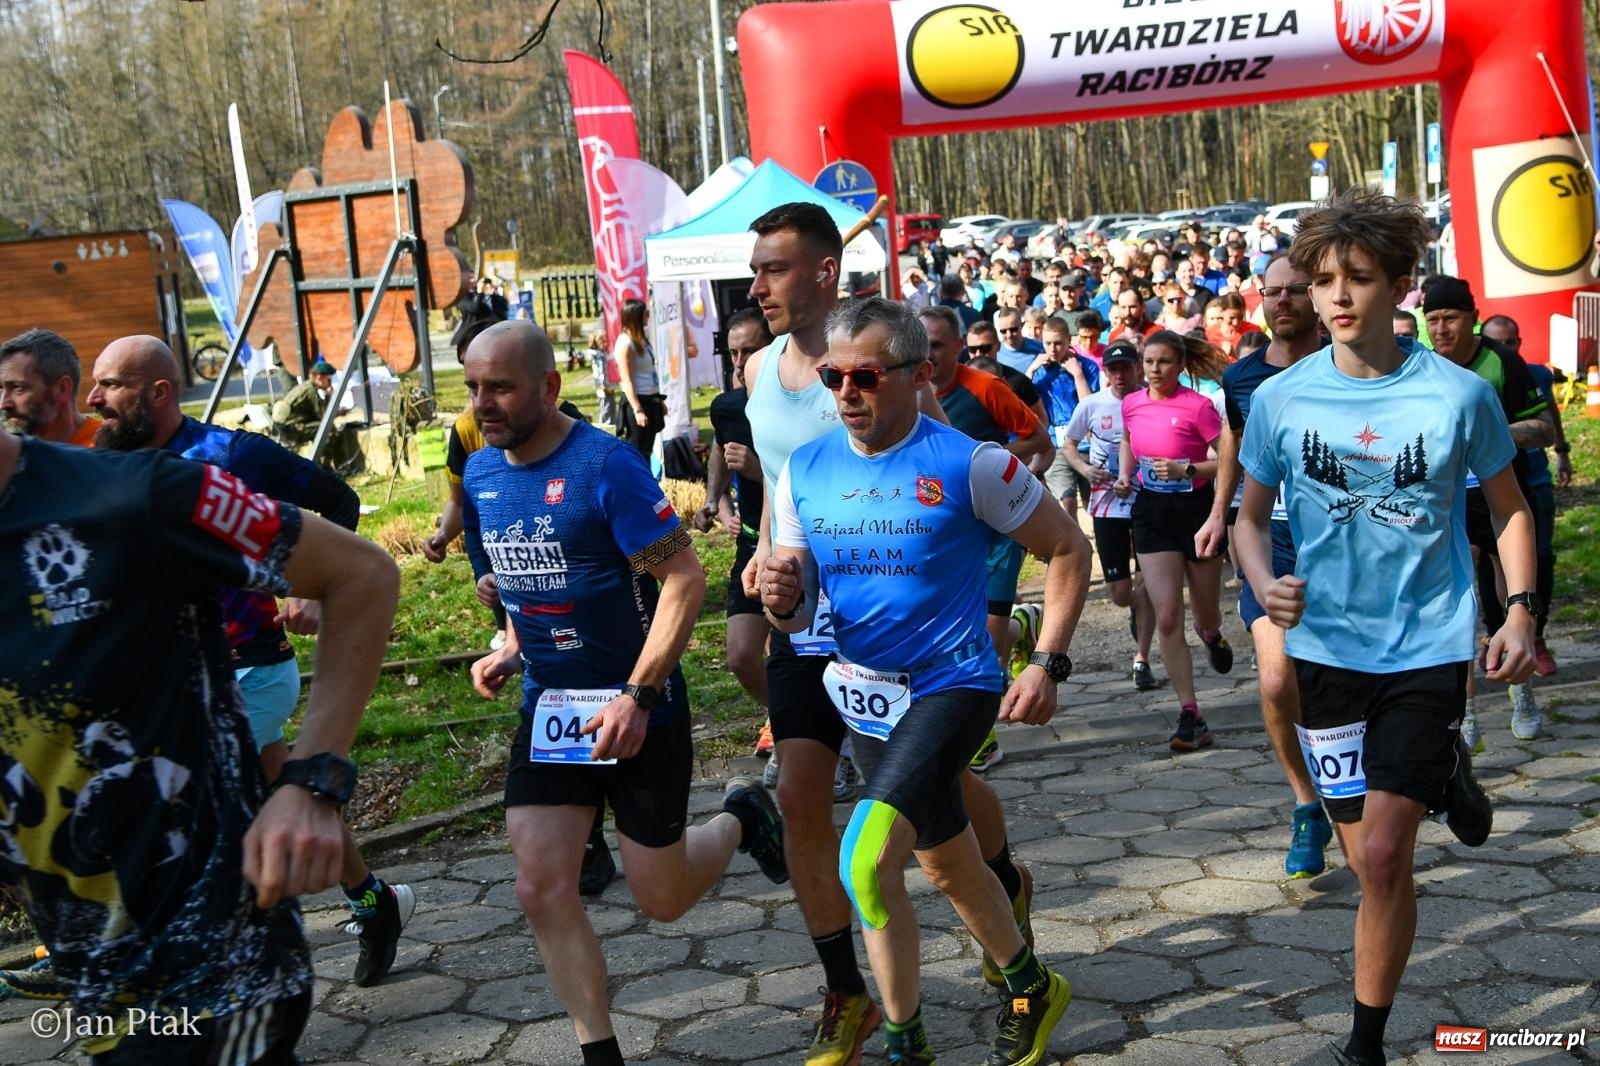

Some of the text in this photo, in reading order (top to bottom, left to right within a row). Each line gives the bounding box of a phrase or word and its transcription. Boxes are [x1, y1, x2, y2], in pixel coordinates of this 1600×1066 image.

[1050, 9, 1298, 59] TWARDZIELA
[1076, 54, 1273, 97] RACIBÓRZ
[811, 517, 934, 539] Zajazd Malibu
[833, 548, 903, 561] TEAM
[825, 563, 918, 577] DREWNIAK
[536, 574, 567, 591] TEAM
[838, 684, 889, 718] 130
[1315, 728, 1363, 742] TWARDZIELA
[1308, 749, 1359, 779] 007
